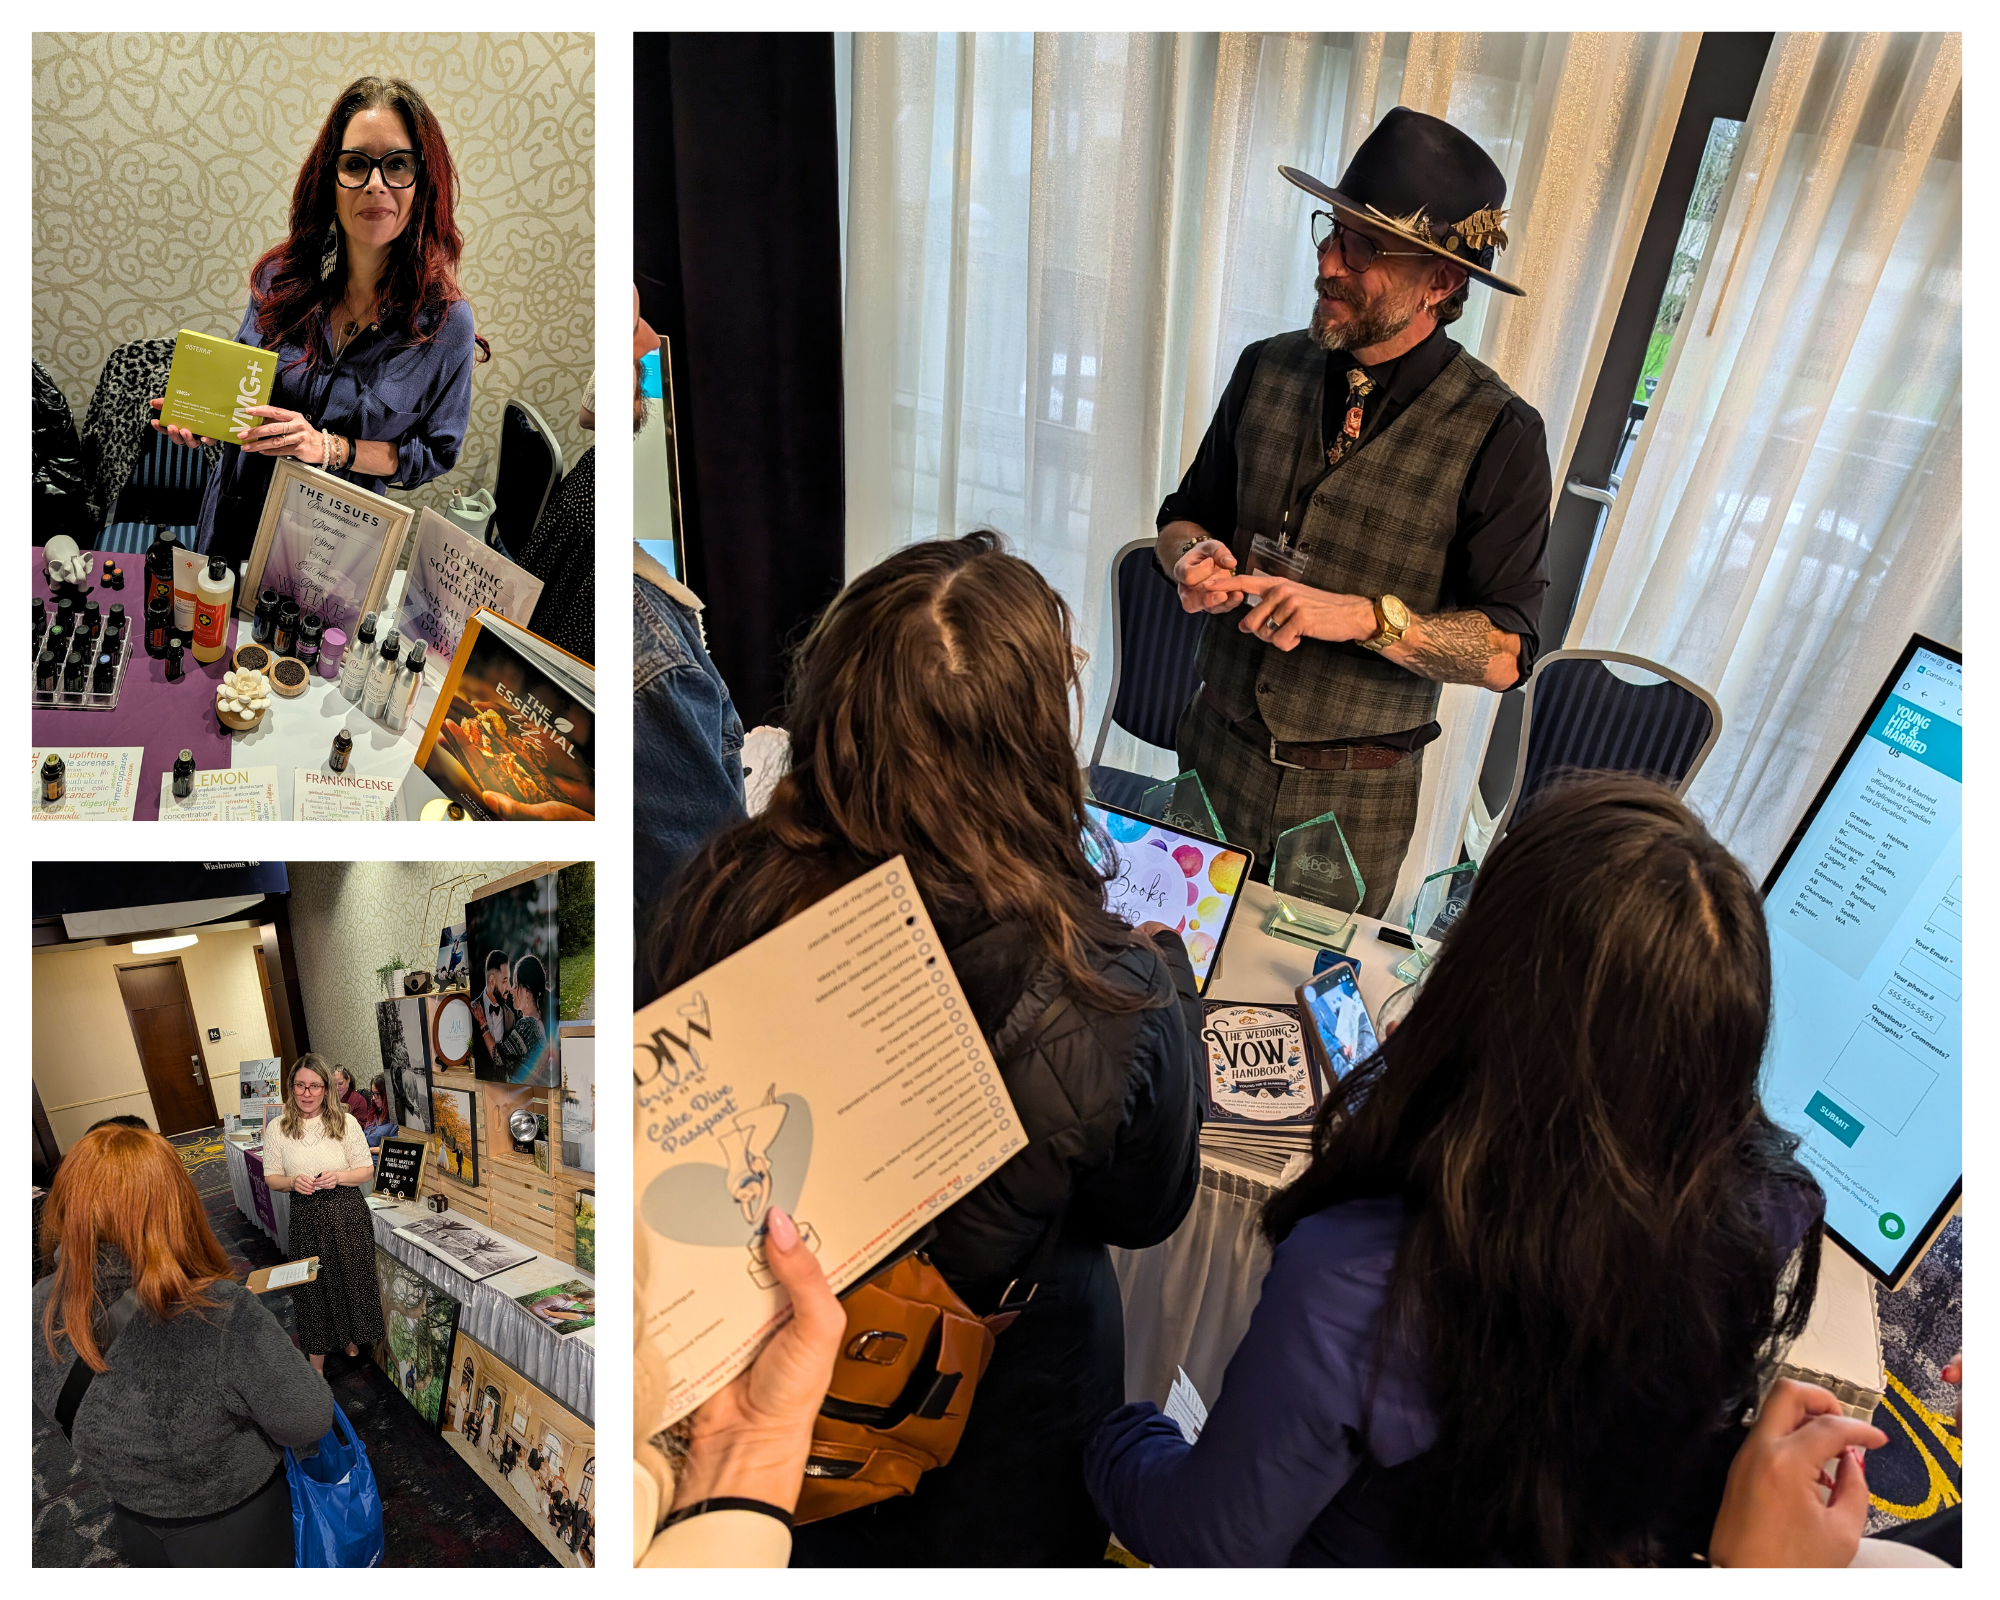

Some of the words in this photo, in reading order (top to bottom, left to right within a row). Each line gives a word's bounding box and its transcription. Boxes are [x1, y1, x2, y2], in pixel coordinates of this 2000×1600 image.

[229, 361, 262, 432] VMG+
[300, 484, 324, 502] THE
[330, 499, 379, 526] ISSUES
[308, 500, 360, 529] Perimenopause
[312, 518, 346, 539] Digestion
[314, 535, 335, 550] Sleep
[309, 548, 331, 566] Stress
[444, 543, 504, 590] LOOKING
[295, 561, 311, 572] Gut
[311, 566, 337, 584] Health
[444, 554, 461, 571] TO
[463, 567, 499, 598] EARN
[278, 574, 302, 598] WE
[304, 589, 346, 620] HAVE
[301, 578, 323, 594] Detox
[429, 557, 462, 586] SOME
[465, 582, 505, 617] EXTRA
[420, 588, 442, 608] ASK
[444, 605, 462, 621] ME
[428, 603, 442, 618] TO
[420, 608, 453, 638] YOUR
[1919, 651, 1930, 660] 1:37
[1926, 670, 1946, 683] Contact
[527, 693, 552, 720] THE
[1895, 704, 1931, 730] YOUNG
[496, 682, 575, 759] ESSENTIAL
[1887, 715, 1910, 732] HIP
[1909, 725, 1919, 739] &
[507, 715, 545, 749] life
[1882, 726, 1927, 754] MARRIED
[69, 751, 108, 760] uplifting
[1889, 747, 1901, 758] US
[114, 753, 128, 801] menopause
[306, 773, 394, 791] FRANKINCENSE
[1876, 768, 1894, 782] Young
[1894, 778, 1906, 788] Hip
[1912, 787, 1937, 804] Married
[81, 800, 117, 808] digestive
[1865, 785, 1875, 794] the
[1875, 790, 1902, 810] following
[1902, 806, 1931, 825] Canadian
[1870, 778, 1896, 794] officiants
[1896, 791, 1906, 800] are
[1907, 796, 1930, 813] located
[1929, 809, 1936, 817] in
[1849, 811, 1872, 828] Greater
[1860, 794, 1872, 804] and
[1872, 800, 1881, 808] US
[1881, 805, 1908, 824] locations.
[1838, 828, 1849, 838] BC
[1844, 819, 1876, 843] Vancouver,
[1886, 833, 1910, 851] Helena,
[1828, 844, 1847, 860] Island,
[1848, 856, 1858, 866] BC
[1834, 836, 1865, 858] Vancouver
[1875, 850, 1887, 860] Los
[1881, 841, 1893, 851] MT
[203, 862, 245, 870] Washrooms
[1310, 859, 1329, 873] BC
[1818, 860, 1828, 870] AB
[1824, 852, 1847, 871] Calgary,
[1865, 867, 1875, 876] CA
[1870, 858, 1897, 878] Angeles,
[1108, 858, 1168, 907] Books
[1809, 876, 1819, 886] AB
[1814, 868, 1845, 892] Edmonton,
[1855, 882, 1866, 893] MT
[1860, 875, 1888, 896] Missoula,
[1799, 892, 1810, 902] BC
[1804, 884, 1834, 908] Okanagan,
[1844, 899, 1856, 909] OR
[1850, 891, 1877, 913] Portland,
[1942, 896, 1955, 907] First
[1121, 902, 1140, 922] $10
[1789, 908, 1800, 918] BC
[1794, 900, 1819, 920] Whistler,
[1835, 915, 1847, 926] WA
[1840, 907, 1862, 926] Seattle,
[1923, 924, 1936, 934] Last
[1914, 938, 1929, 952] Your
[1929, 947, 1949, 963] Email
[1892, 971, 1907, 984] Your
[1906, 980, 1929, 998] phone
[1887, 988, 1934, 1022] 555-555-5555
[1225, 1031, 1242, 1042] THE
[1246, 1027, 1290, 1041] WEDDING
[1871, 1014, 1904, 1040] Thoughts?
[1871, 1003, 1907, 1030] Questions?
[1910, 1030, 1950, 1060] Comments?
[1211, 1031, 1285, 1069] VOW
[1232, 1064, 1287, 1079] HANDBOOK
[646, 1110, 692, 1143] Cake
[690, 1085, 733, 1112] Dive
[661, 1096, 738, 1154] Passport
[1819, 1105, 1850, 1131] SUBMIT
[1809, 1145, 1817, 1154] site
[1822, 1156, 1845, 1176] protected
[1844, 1174, 1851, 1182] by
[1851, 1179, 1880, 1204] reCAPTCHA
[1816, 1163, 1825, 1172] and
[1825, 1170, 1834, 1179] the
[1834, 1176, 1850, 1193] Google
[1850, 1190, 1868, 1207] Privacy
